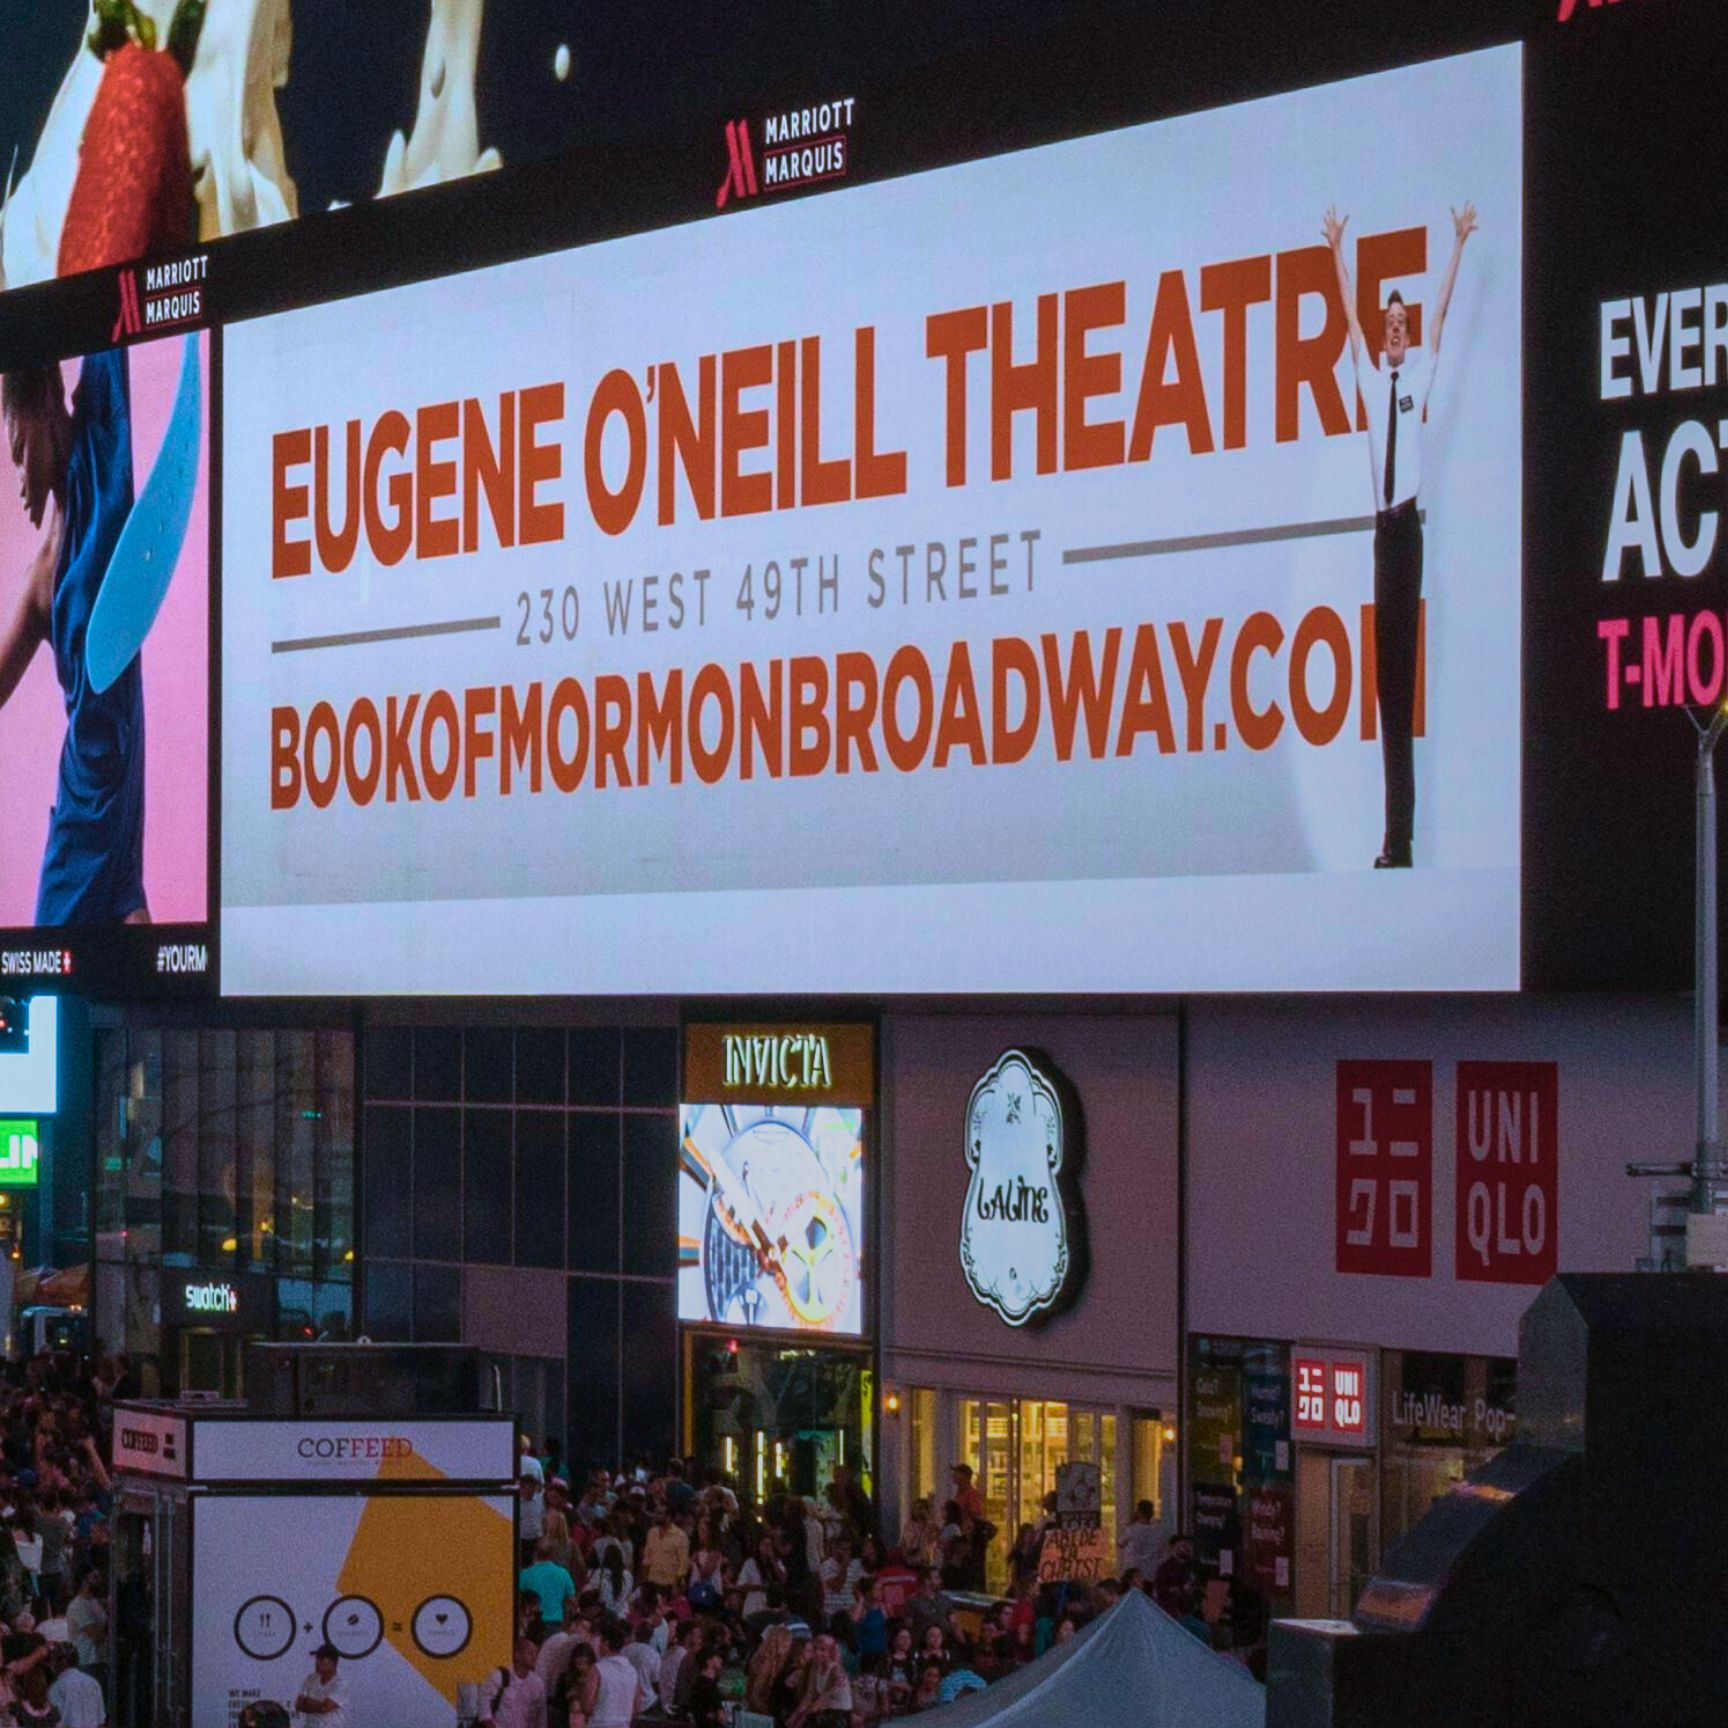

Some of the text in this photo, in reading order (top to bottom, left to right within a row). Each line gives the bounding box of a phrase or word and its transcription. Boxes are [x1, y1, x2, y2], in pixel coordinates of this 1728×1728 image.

[765, 98, 856, 146] MARRIOTT
[764, 139, 844, 184] MARQUIS
[146, 255, 209, 292] MARRIOTT
[146, 291, 200, 325] MARQUIS
[270, 380, 565, 582] EUGENE
[584, 332, 907, 537] O'NEILL
[515, 527, 1044, 649] 230 WEST 49TH STREET
[1, 952, 61, 974] SWISS MADE
[722, 1034, 833, 1090] INVICTA
[1348, 1088, 1419, 1158] ユニ
[1467, 1089, 1540, 1164] UNI
[1467, 1182, 1545, 1268] QLO
[185, 1282, 228, 1312] swatch
[1334, 1369, 1359, 1397] UNI
[1334, 1399, 1362, 1428] QLO
[1392, 1391, 1466, 1432] LifeWear
[297, 1438, 414, 1459] COFFEED
